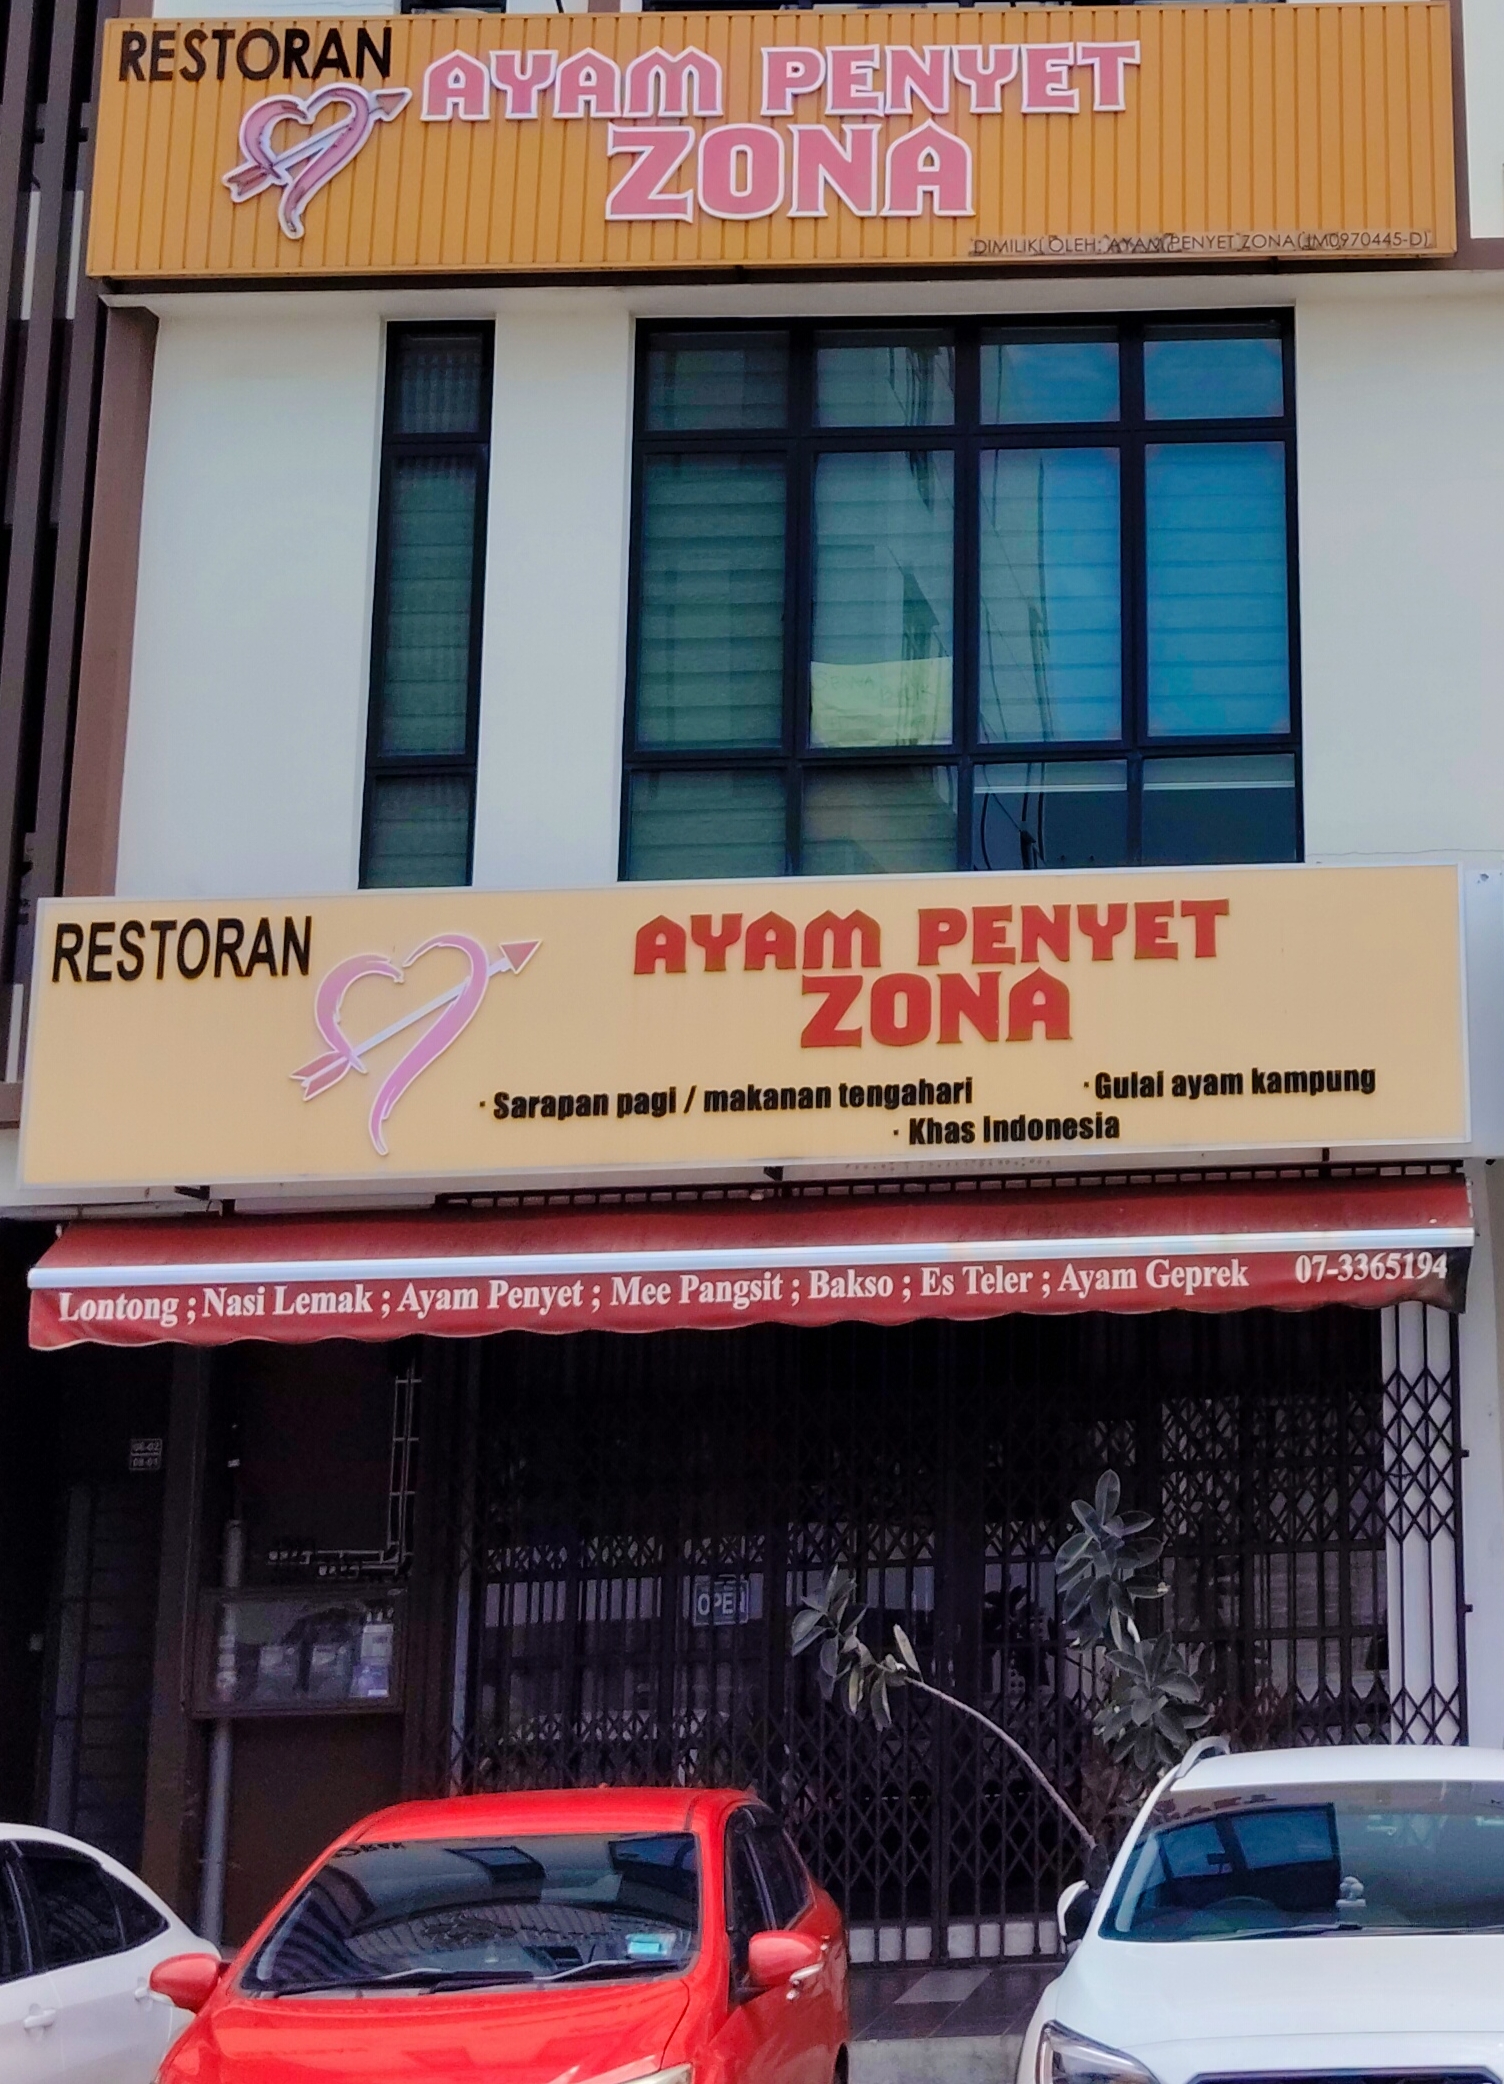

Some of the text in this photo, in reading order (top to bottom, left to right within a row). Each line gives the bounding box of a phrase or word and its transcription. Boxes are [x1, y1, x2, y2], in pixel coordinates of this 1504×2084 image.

[119, 27, 391, 82] RESTORAN
[421, 40, 1141, 122] AYAM PENYET
[605, 118, 976, 223] ZONA
[1168, 234, 1235, 252] PENYET
[53, 916, 312, 983] RESTORAN
[634, 899, 1230, 976] AYAM PENYET
[801, 967, 1072, 1049] ZONA
[493, 1091, 608, 1121] Sarapan
[616, 1087, 677, 1119] pagi
[703, 1084, 833, 1113] makanan
[838, 1077, 973, 1110] tengahari
[1095, 1067, 1376, 1100] Gulai ayam kampung
[909, 1112, 1120, 1145] Khas Indonesia
[58, 1292, 180, 1328] Lontong
[201, 1285, 266, 1318] Nasi
[271, 1279, 374, 1315] Lemak
[396, 1282, 479, 1320] Ayam
[487, 1279, 585, 1316] Penyet
[609, 1275, 672, 1306] Mee
[678, 1271, 784, 1310] Pangsit
[807, 1268, 894, 1300] Bakso
[919, 1266, 955, 1297] Es
[961, 1264, 1034, 1295] Teler
[1057, 1263, 1138, 1299] Ayam
[1145, 1258, 1250, 1296] Geprek
[1295, 1251, 1448, 1284] 07-3365194
